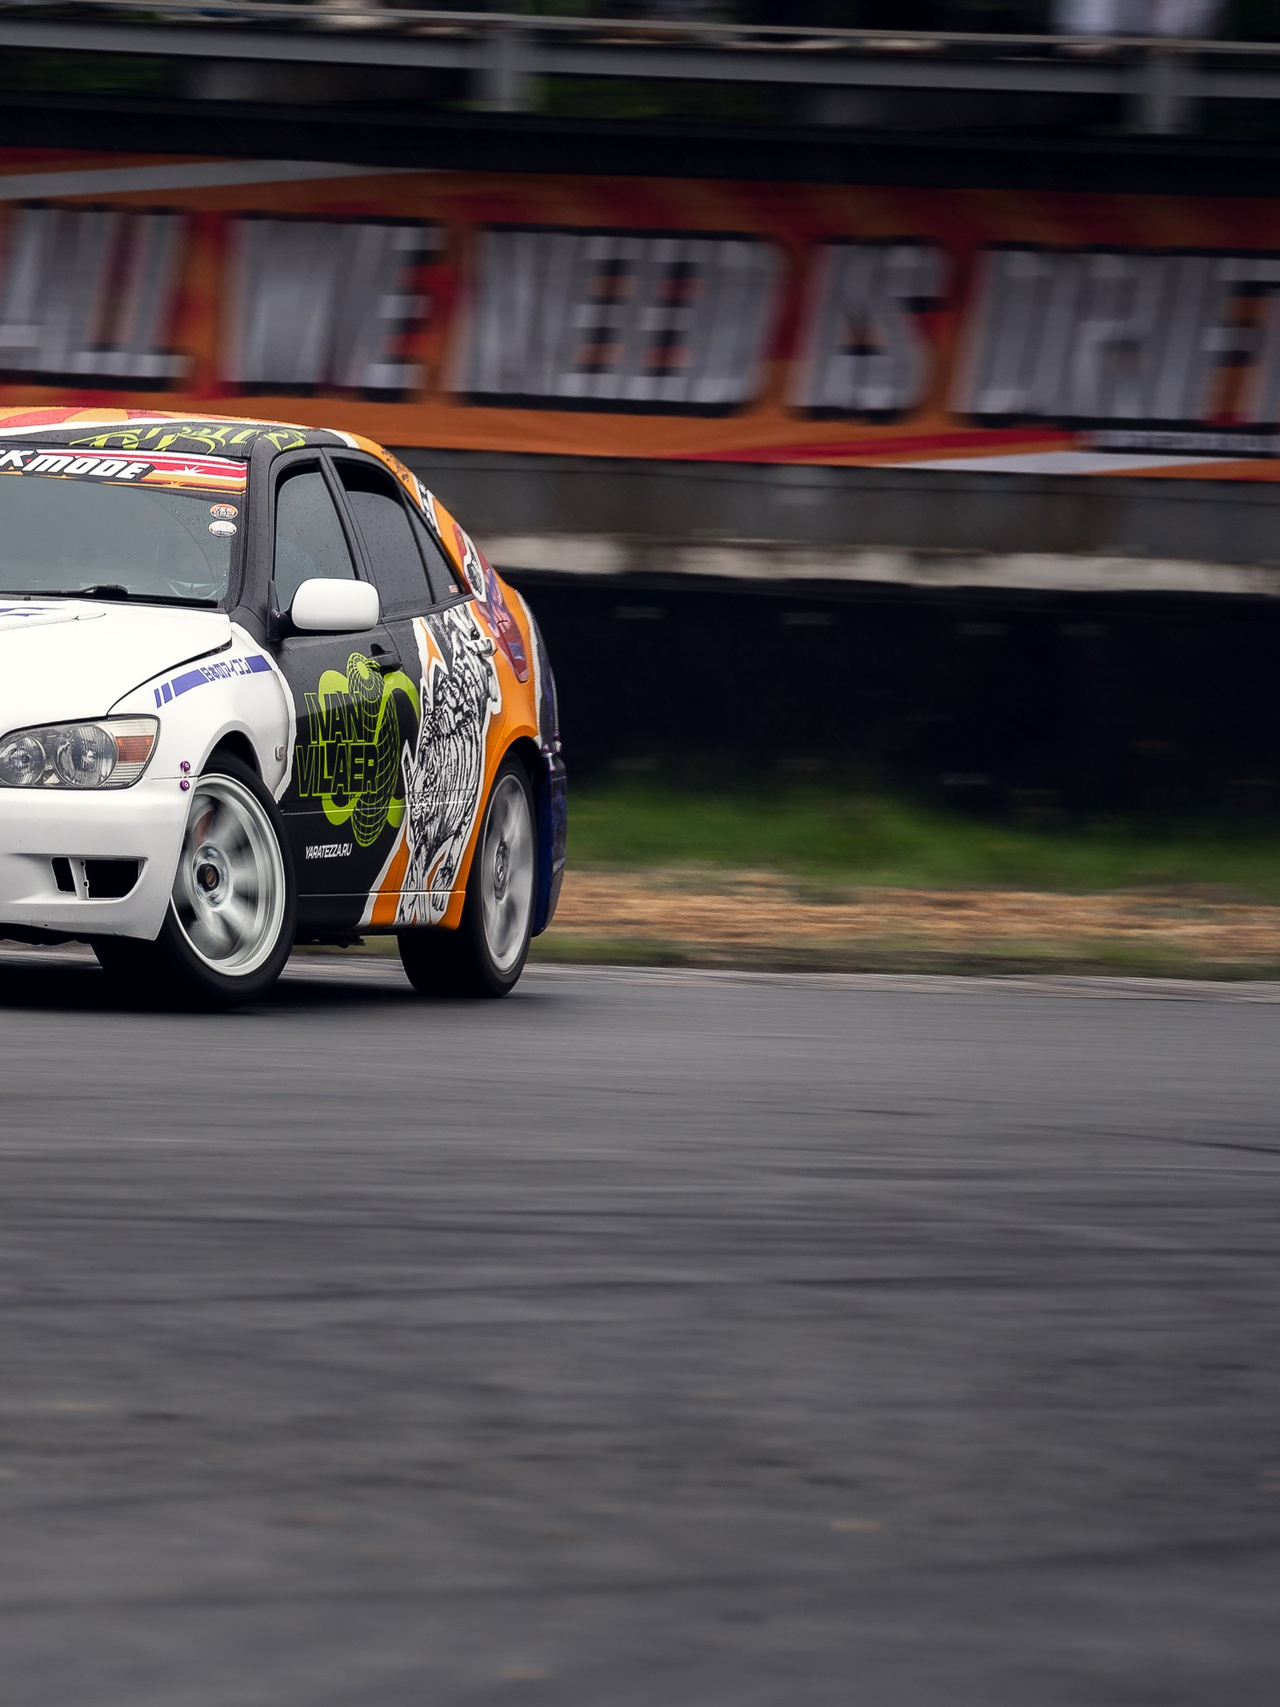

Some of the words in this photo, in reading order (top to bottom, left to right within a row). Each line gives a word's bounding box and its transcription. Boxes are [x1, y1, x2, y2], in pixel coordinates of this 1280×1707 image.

[218, 217, 442, 392] WE
[438, 227, 782, 404] NEED
[786, 244, 950, 412] IS
[303, 690, 366, 744] IVAN
[295, 743, 380, 797] VILAER
[305, 843, 353, 859] YARATEZZA.RU
